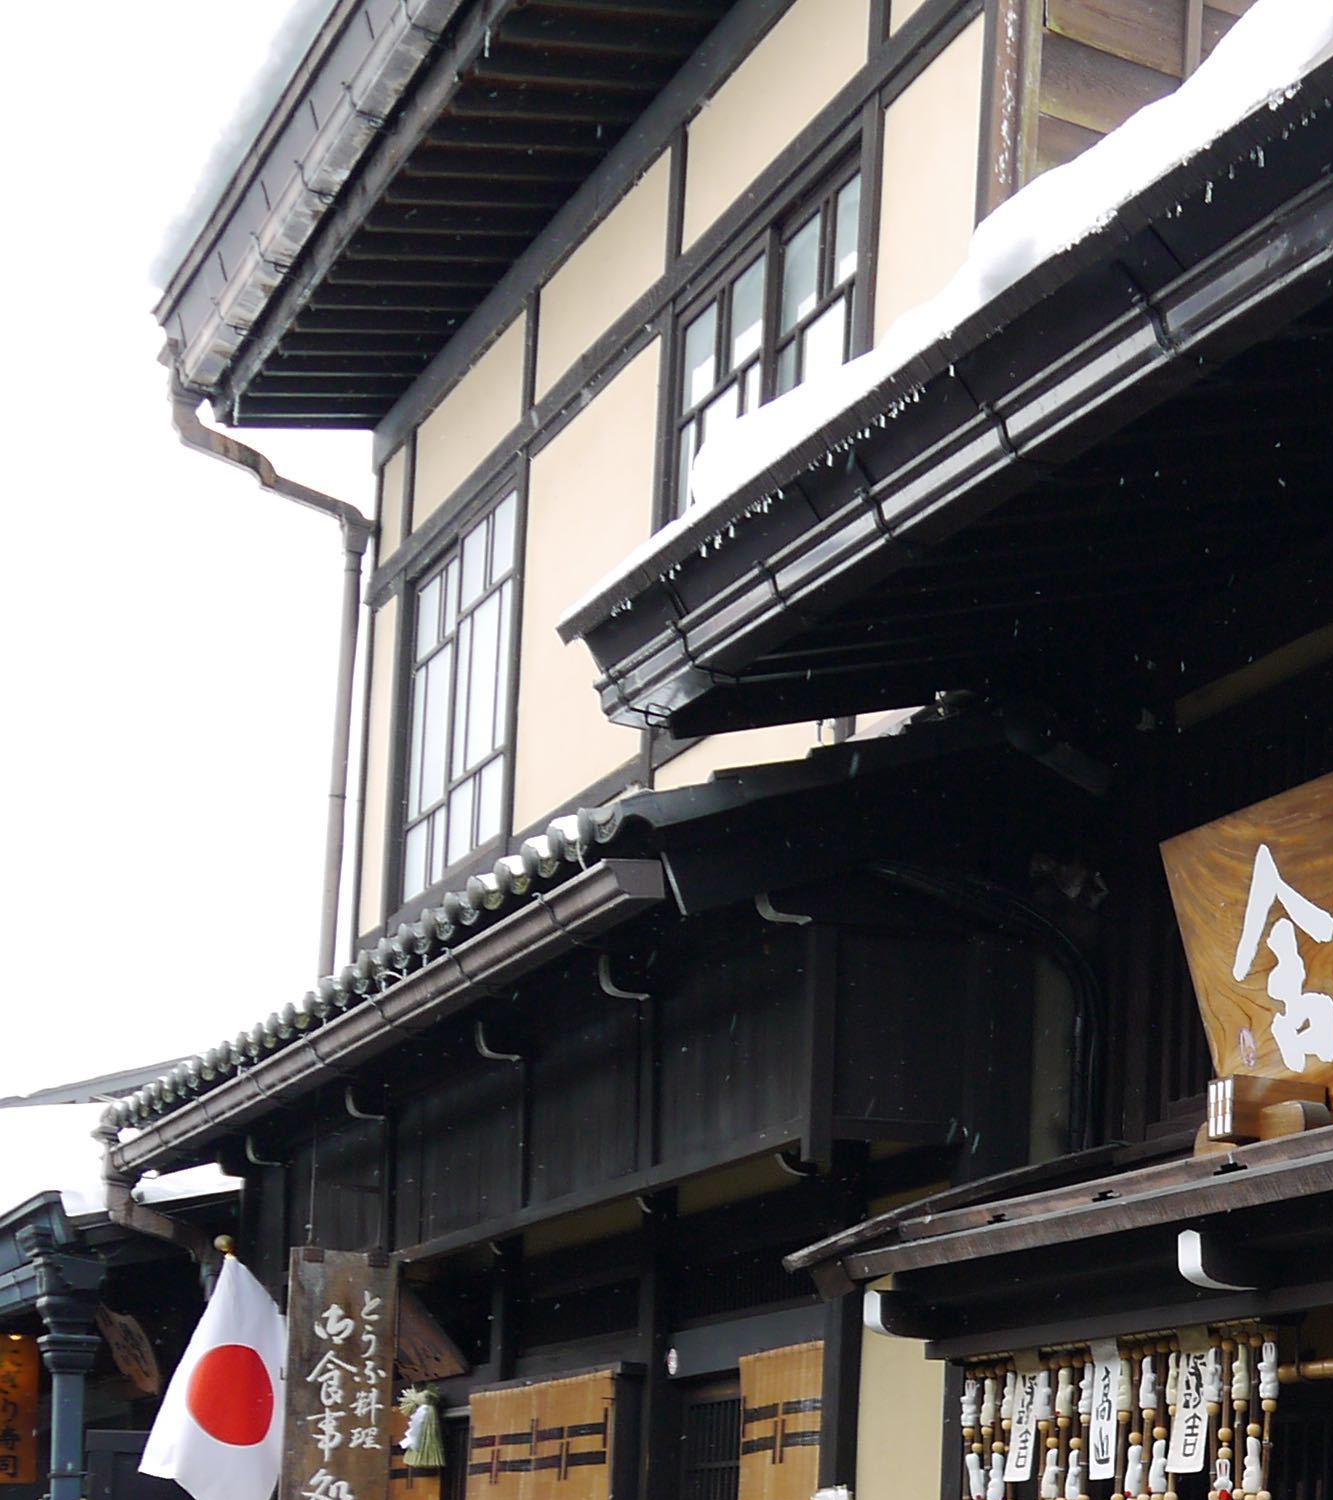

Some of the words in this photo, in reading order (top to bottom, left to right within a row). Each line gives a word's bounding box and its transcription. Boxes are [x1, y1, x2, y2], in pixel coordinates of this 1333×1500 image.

[348, 1290, 387, 1450] とうふ料理
